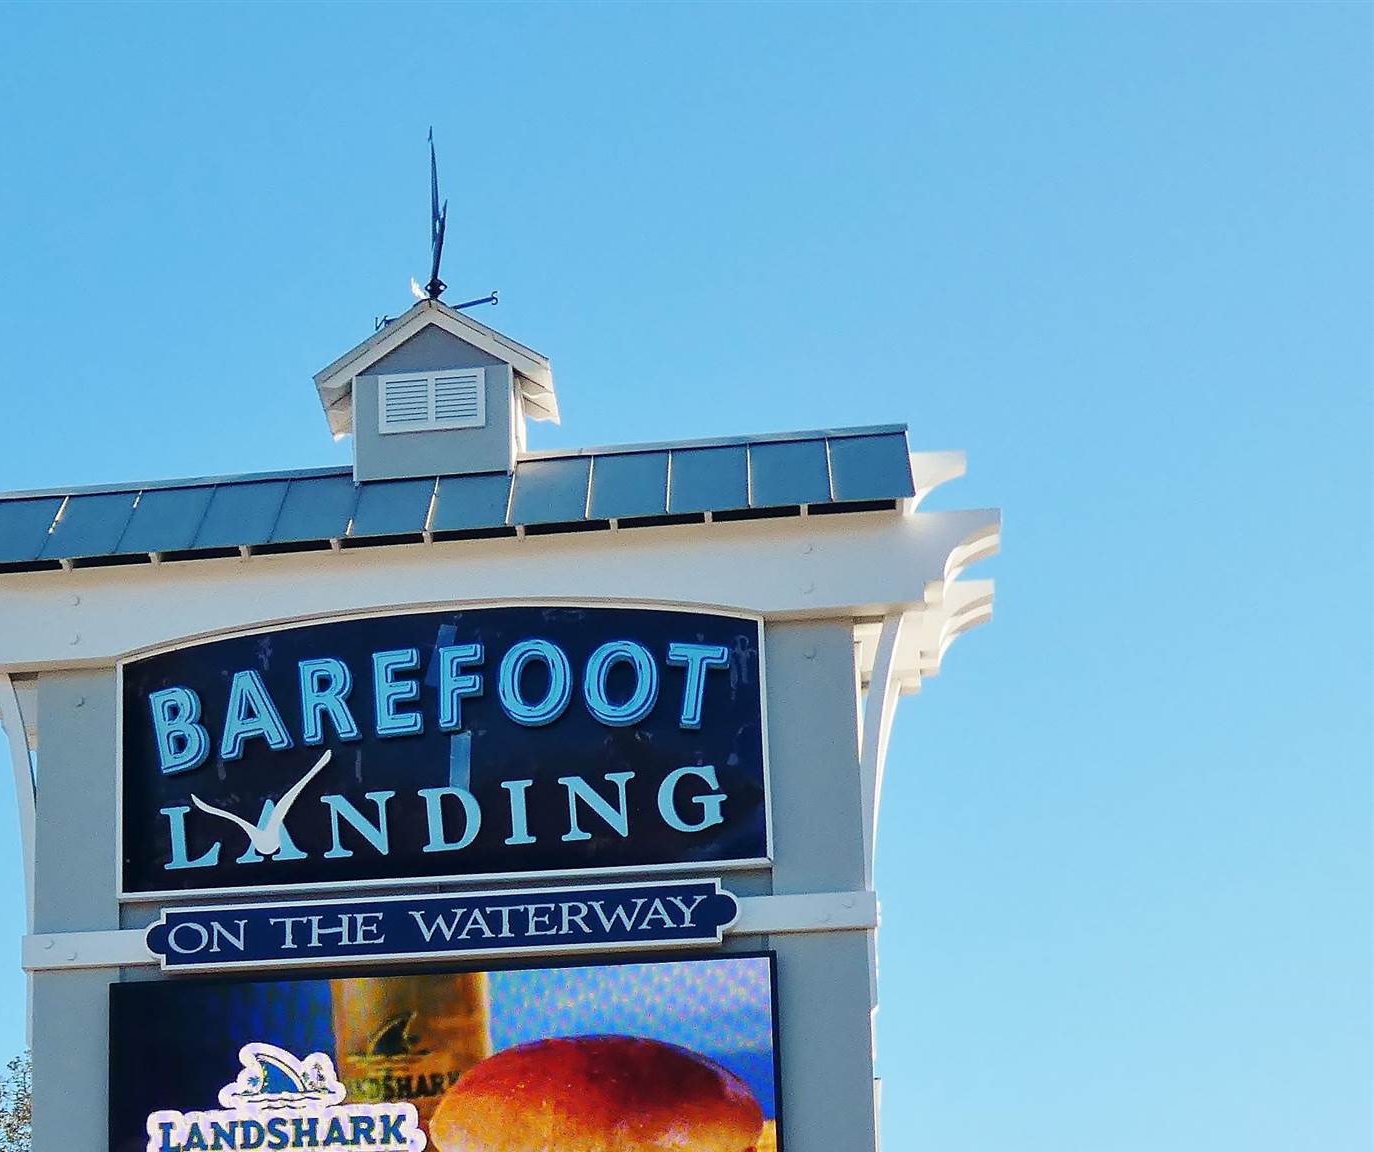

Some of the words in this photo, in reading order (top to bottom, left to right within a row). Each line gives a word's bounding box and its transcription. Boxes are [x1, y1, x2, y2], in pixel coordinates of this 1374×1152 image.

[148, 638, 729, 775] BAREFOOT
[160, 764, 728, 870] LANDING
[166, 920, 247, 955] ON
[269, 913, 385, 948] THE
[408, 894, 708, 941] WATERWAY
